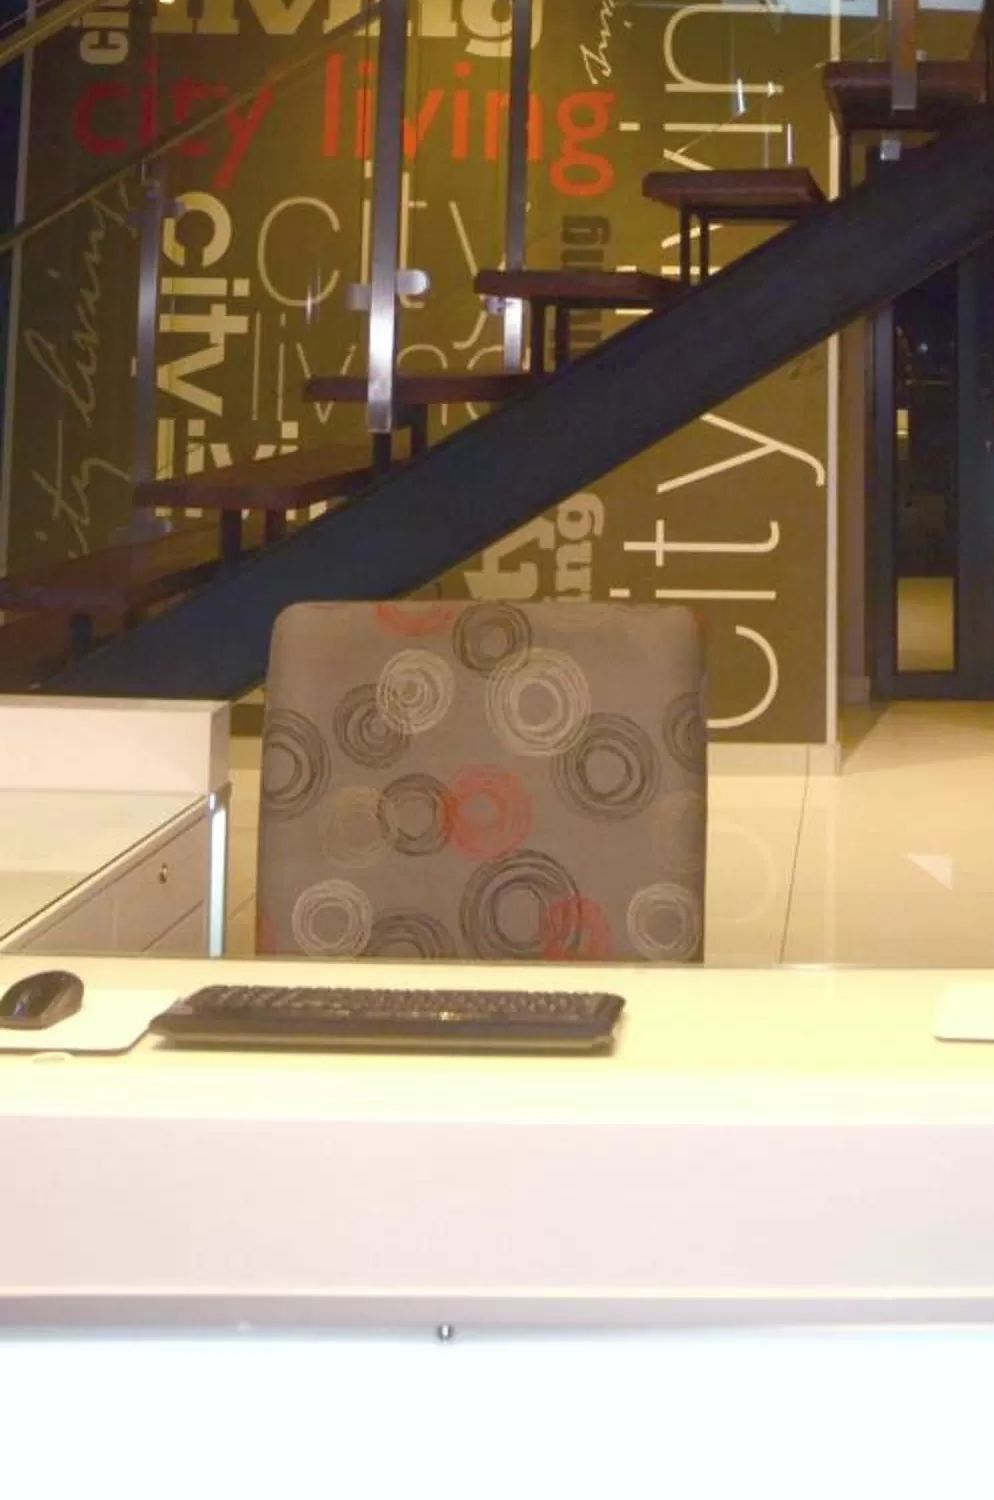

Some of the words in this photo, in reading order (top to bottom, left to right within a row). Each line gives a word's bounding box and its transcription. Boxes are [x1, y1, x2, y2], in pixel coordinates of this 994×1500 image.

[72, 52, 276, 190] city
[322, 52, 614, 197] living
[156, 191, 250, 417] city
[609, 412, 825, 730] city
